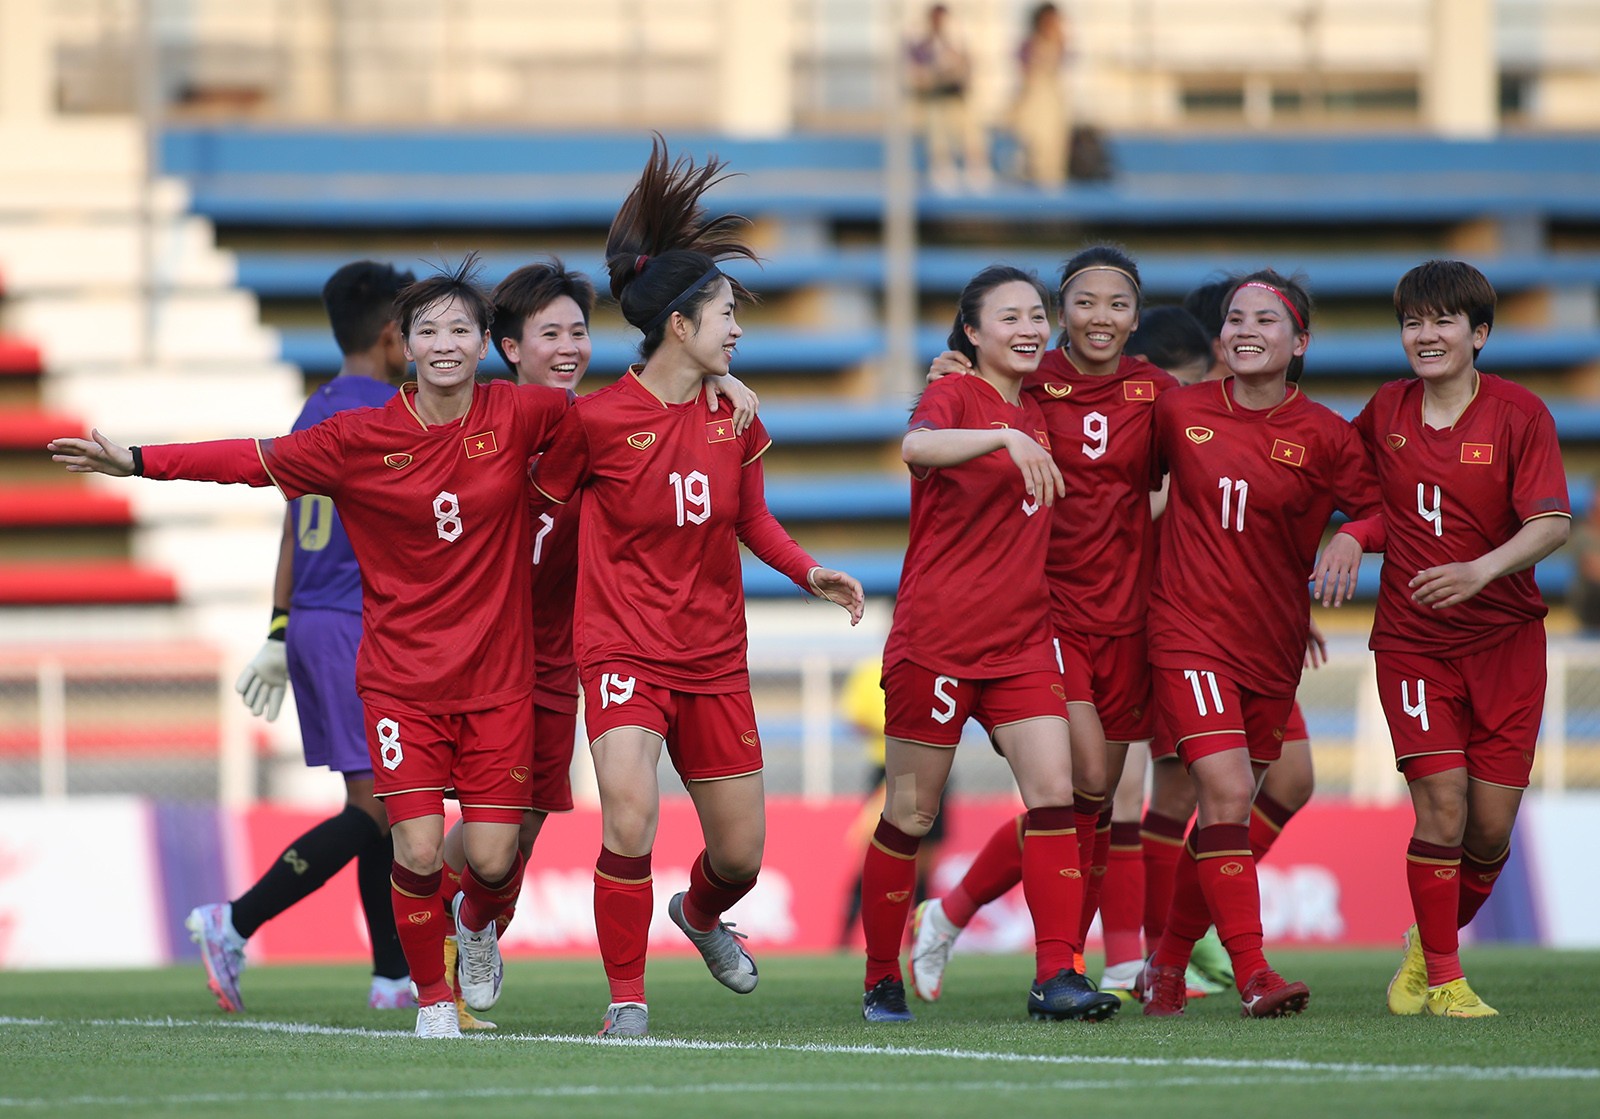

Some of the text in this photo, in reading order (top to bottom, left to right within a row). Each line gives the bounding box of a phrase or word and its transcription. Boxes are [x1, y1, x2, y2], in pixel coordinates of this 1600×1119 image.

[1082, 411, 1108, 460] 9
[432, 491, 463, 542] 8
[669, 470, 711, 527] 19
[1218, 477, 1248, 532] 11
[1417, 483, 1442, 537] 4
[532, 513, 554, 565] 7
[600, 674, 636, 709] 19
[1184, 670, 1224, 716] 11
[1402, 679, 1429, 731] 4
[377, 718, 403, 770] 8
